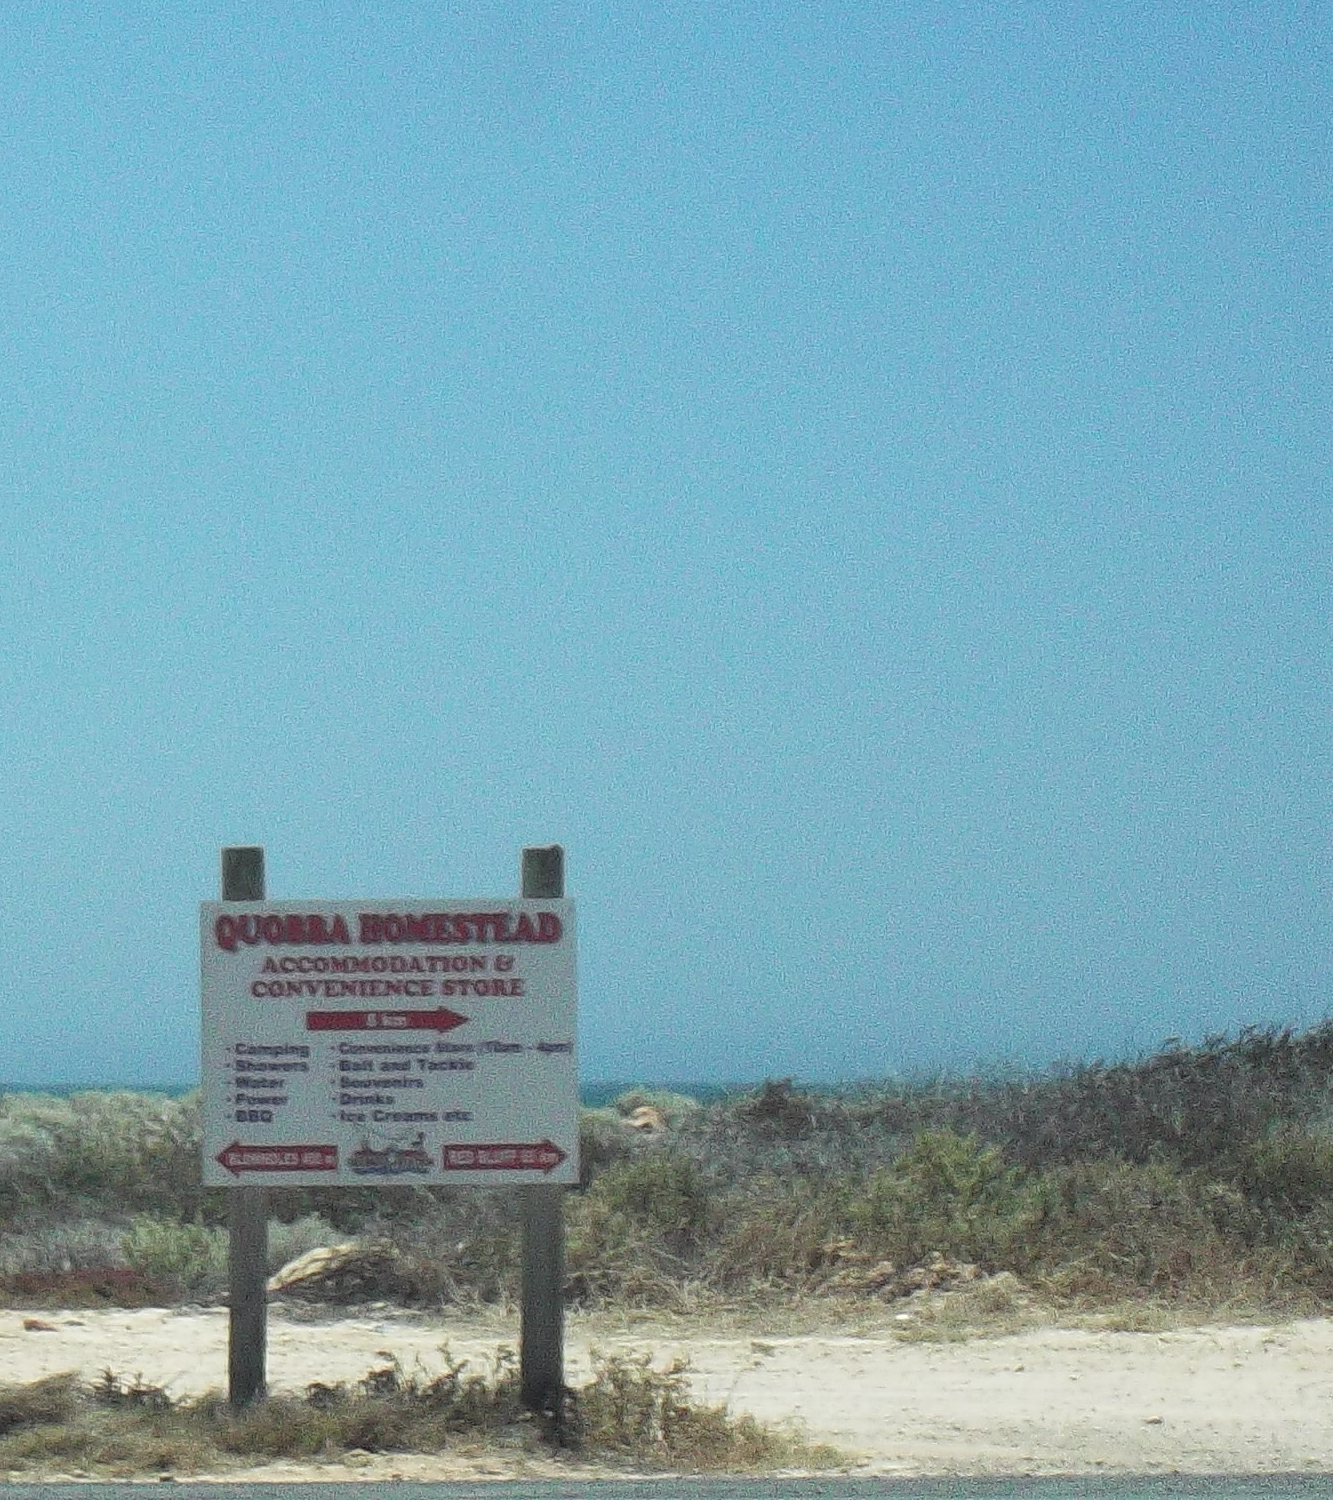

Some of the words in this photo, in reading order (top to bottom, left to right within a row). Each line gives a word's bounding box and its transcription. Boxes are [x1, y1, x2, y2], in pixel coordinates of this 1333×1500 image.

[216, 913, 350, 952] QUOBBA
[358, 912, 564, 945] HOMESTEAD
[262, 955, 487, 974] ACCOMMODATION
[493, 955, 515, 972] &
[251, 979, 434, 998] CONVENIENCE
[441, 979, 525, 997] STORE
[235, 1043, 310, 1059] Camping
[339, 1042, 430, 1055] Convenience
[235, 1060, 310, 1072] Showers
[339, 1060, 374, 1072] Bait
[380, 1060, 412, 1072] and
[417, 1059, 476, 1072] Tackle
[235, 1076, 286, 1088] Water
[339, 1075, 425, 1088] Souvenirs
[235, 1093, 289, 1105] Power
[340, 1092, 396, 1105] Drinks
[235, 1109, 274, 1123] BBQ
[340, 1110, 367, 1122] Ice
[372, 1109, 438, 1122] Creams
